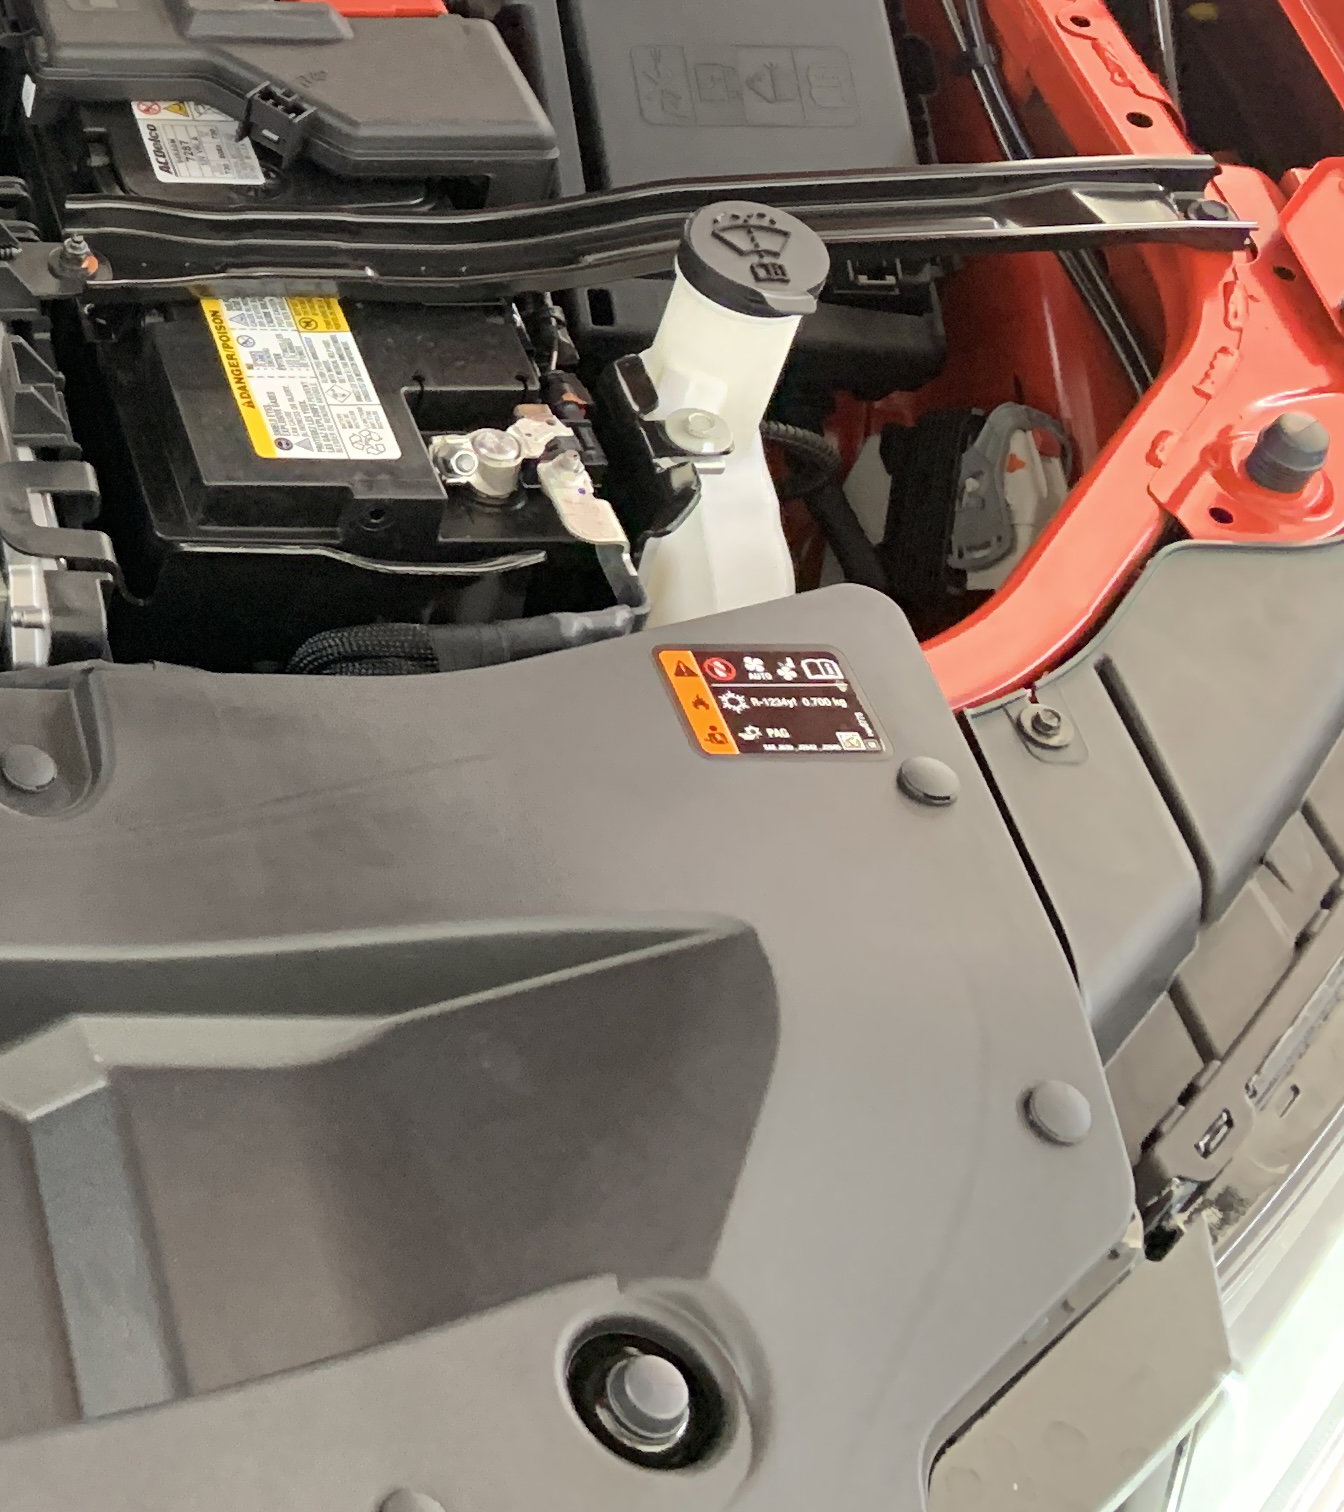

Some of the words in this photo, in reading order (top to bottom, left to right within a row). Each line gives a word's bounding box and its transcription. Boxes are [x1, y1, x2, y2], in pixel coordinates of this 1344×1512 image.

[146, 123, 173, 175] ACDelco
[209, 310, 246, 399] DANGER/POISON
[748, 672, 773, 681] AUTO
[750, 697, 798, 709] R-1234yf
[802, 697, 832, 707] 0.700
[833, 697, 848, 709] kg
[765, 727, 791, 739] PAG
